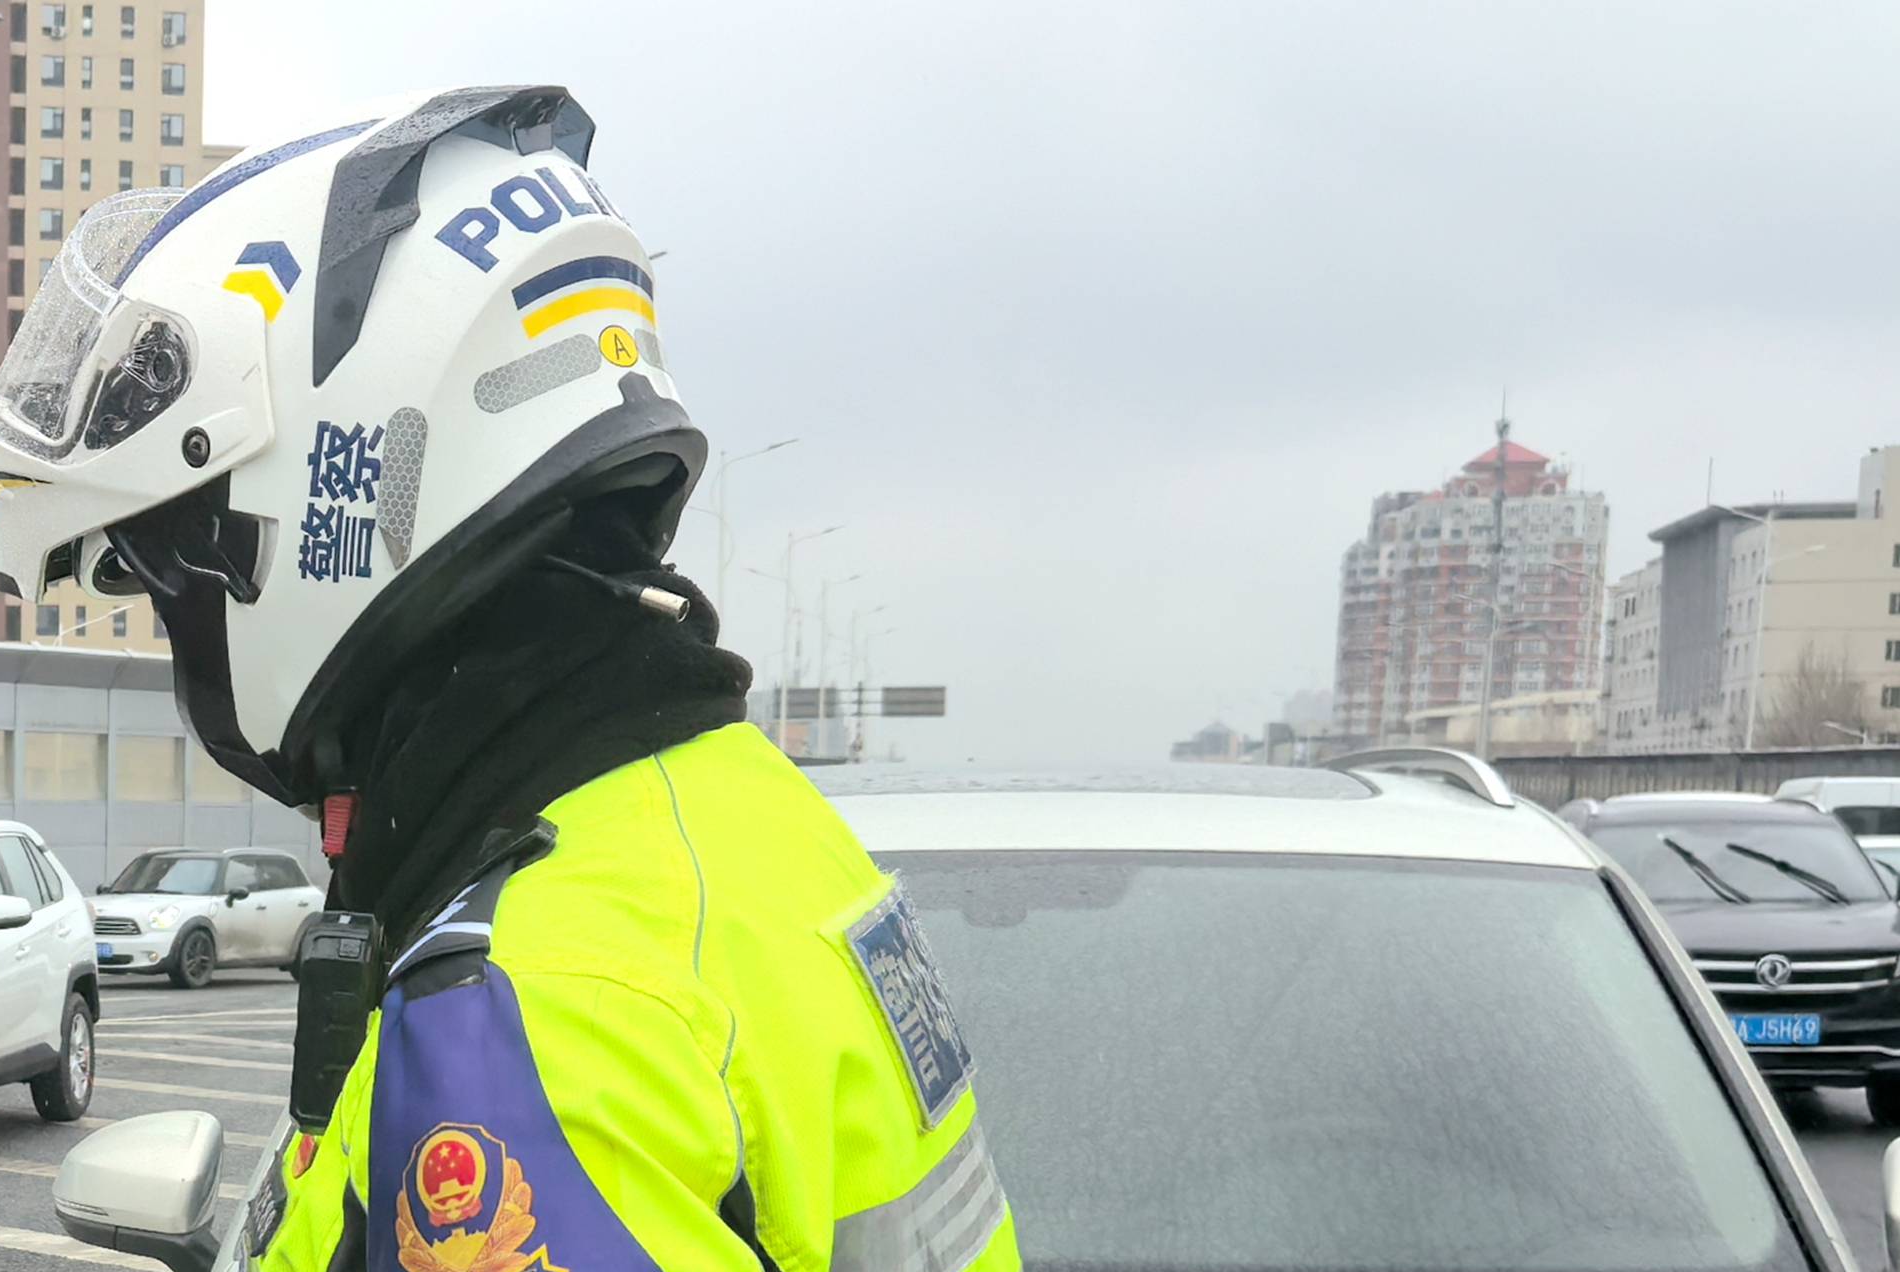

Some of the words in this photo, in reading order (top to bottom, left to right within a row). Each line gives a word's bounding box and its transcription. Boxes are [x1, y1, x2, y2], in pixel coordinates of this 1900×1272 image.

[434, 166, 631, 273] POLI
[614, 332, 632, 361] A
[298, 420, 385, 583] 警察
